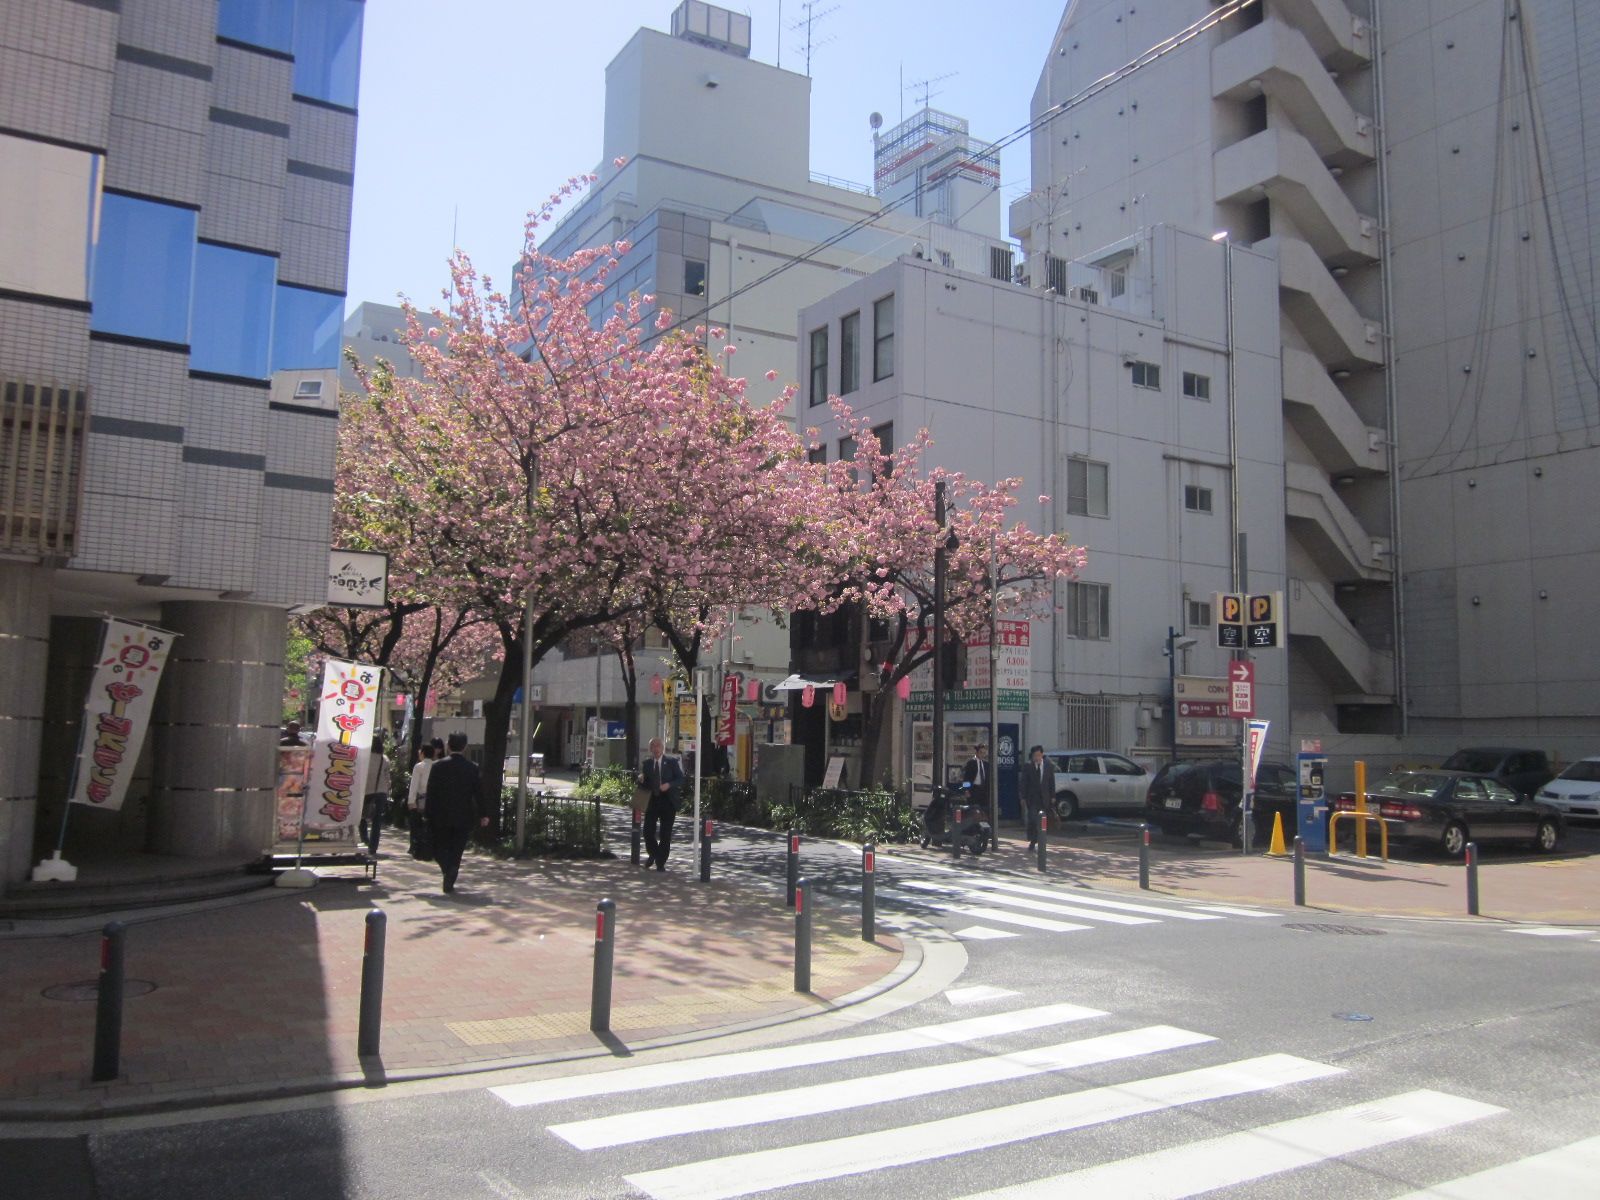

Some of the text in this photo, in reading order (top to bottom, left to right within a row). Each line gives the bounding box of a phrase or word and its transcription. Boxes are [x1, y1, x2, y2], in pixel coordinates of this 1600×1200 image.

[1225, 598, 1238, 620] P
[1253, 598, 1268, 620] P
[1254, 625, 1270, 645] 空
